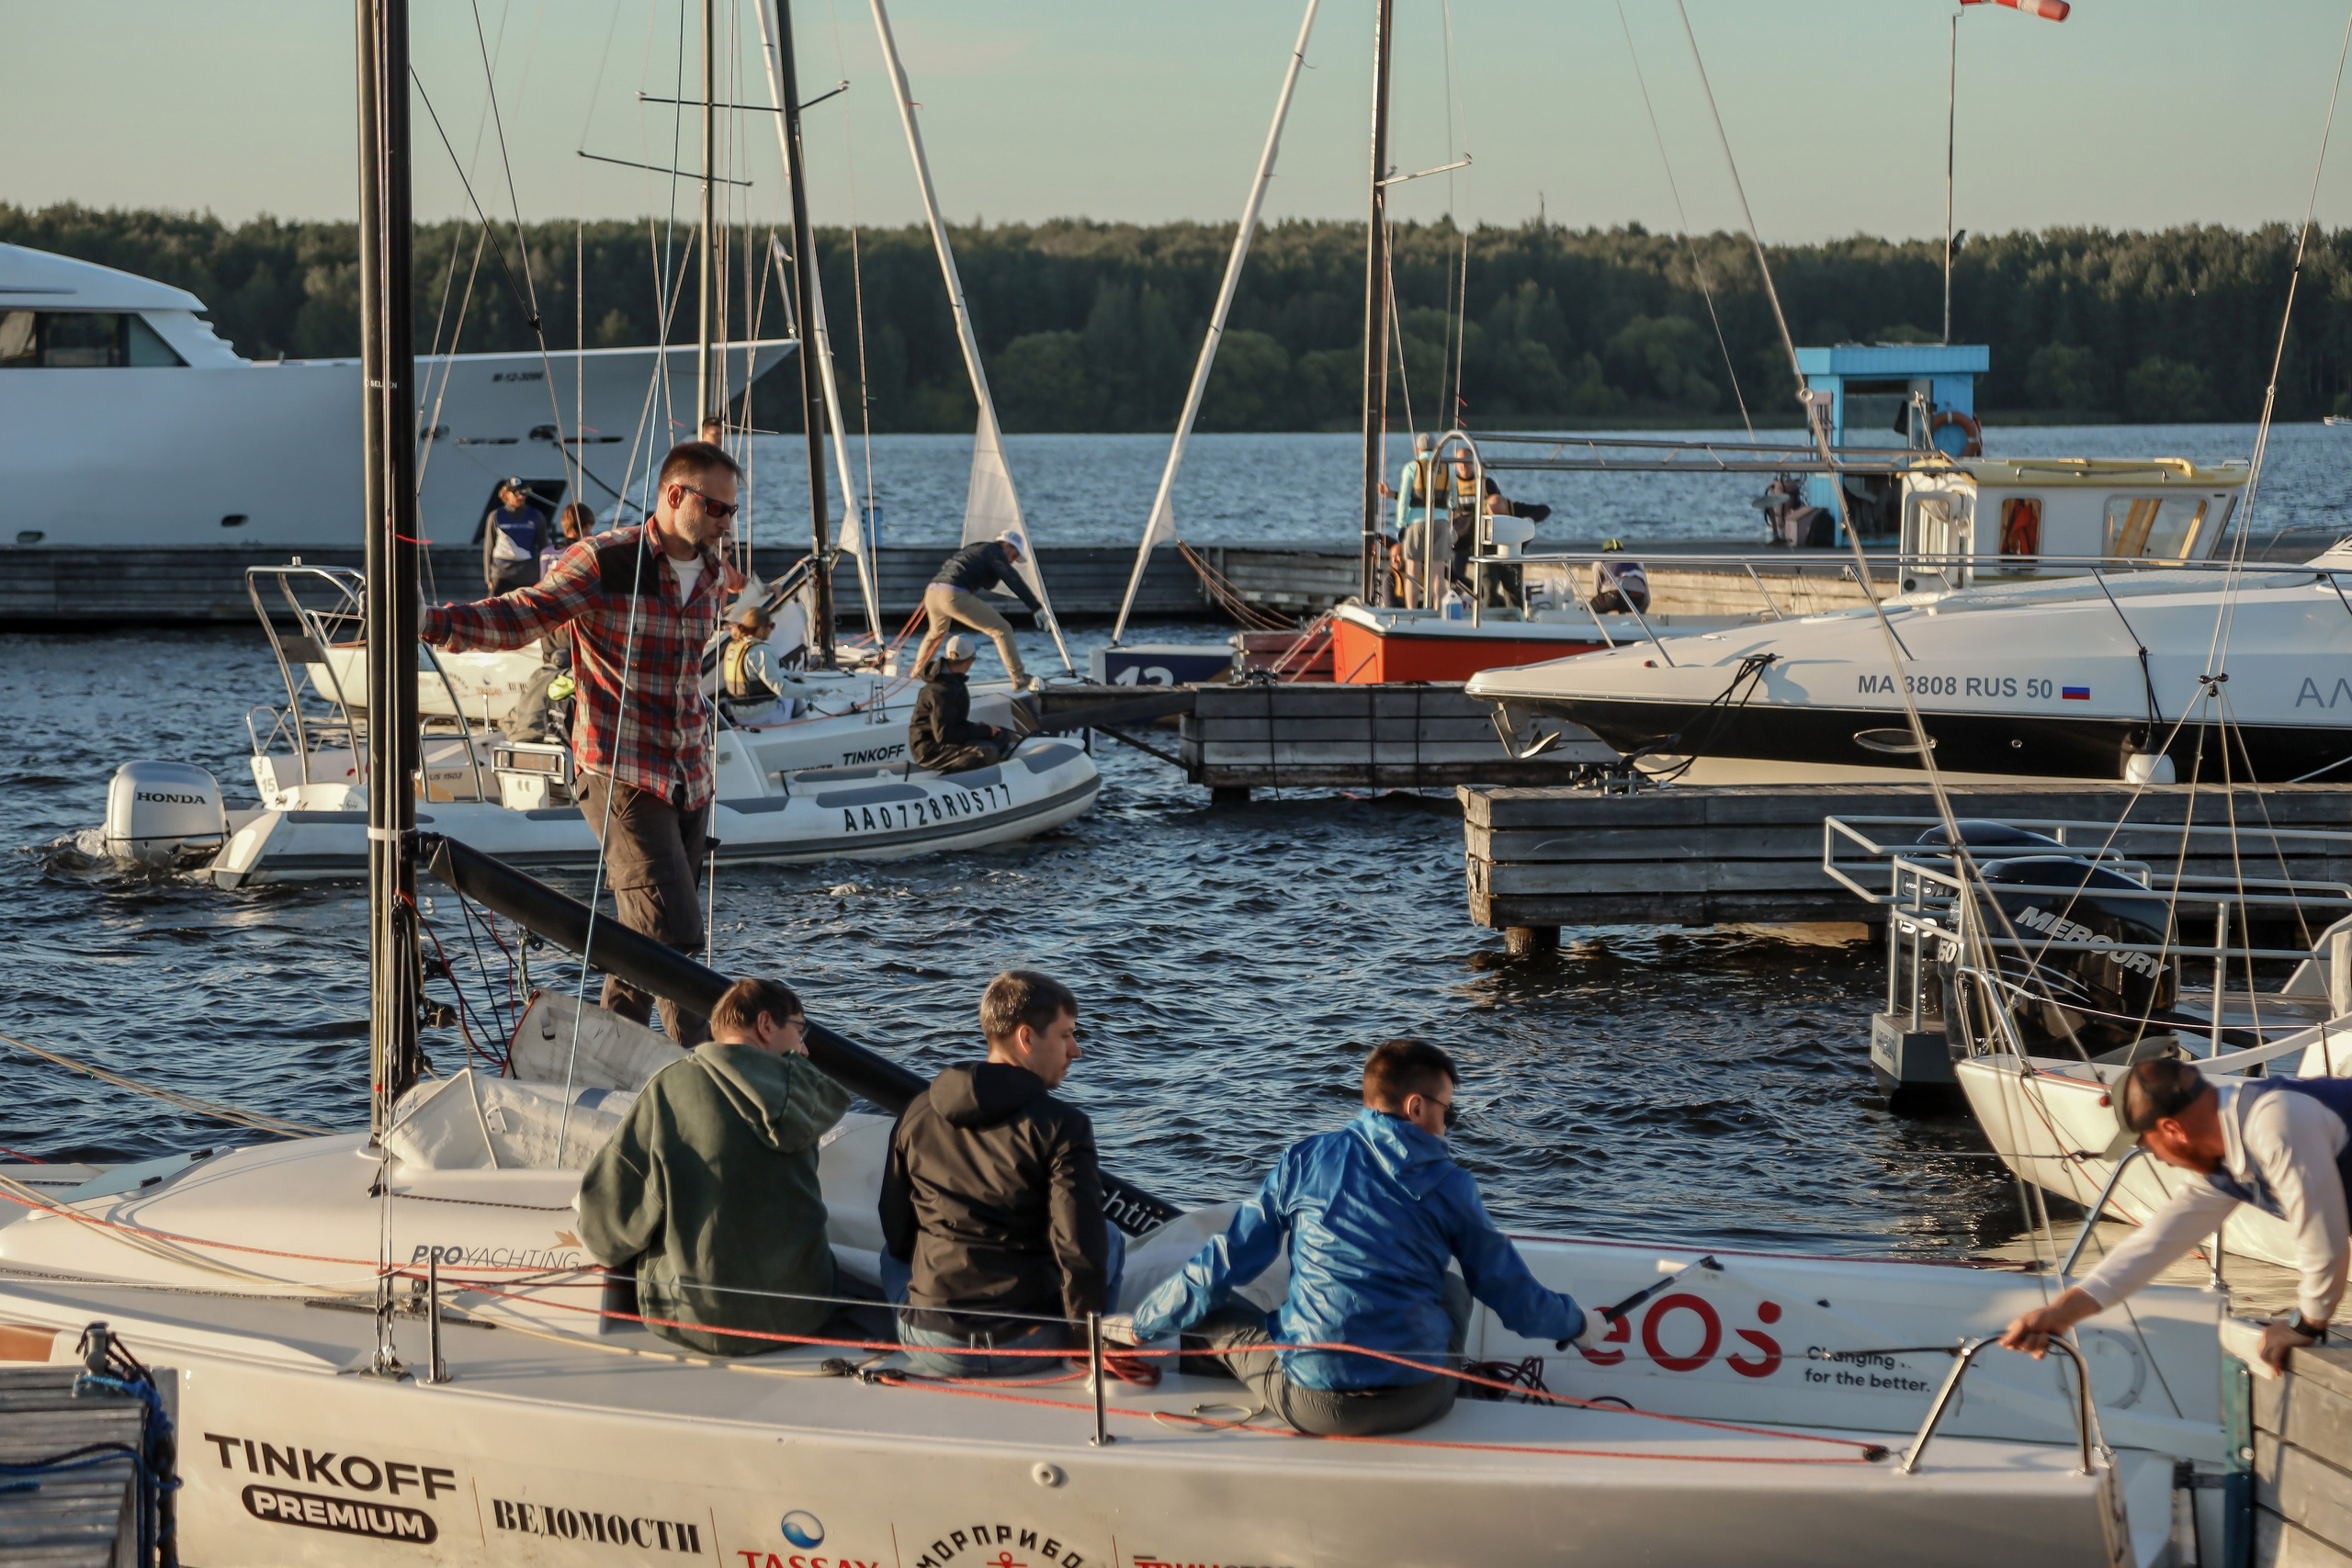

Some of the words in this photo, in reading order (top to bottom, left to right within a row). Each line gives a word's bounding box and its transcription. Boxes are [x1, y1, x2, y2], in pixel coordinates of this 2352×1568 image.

[370, 379, 397, 389] SELN
[1858, 675, 1895, 694] MA
[1905, 675, 1958, 695] 3808
[1966, 677, 2018, 698] RUS
[2026, 679, 2053, 699] 50
[842, 744, 906, 766] TINKOFF
[262, 778, 276, 793] 15
[137, 792, 206, 805] HONDA
[2015, 906, 2171, 978] MERCURY
[1102, 1190, 1165, 1232] htin
[1805, 1368, 1831, 1383] for
[1836, 1370, 1866, 1386] the
[1870, 1373, 1931, 1393] better.
[203, 1432, 457, 1500] TINKOFF
[252, 1490, 426, 1539] PREMIUM
[492, 1498, 704, 1554] ВЕДОМОСТИ
